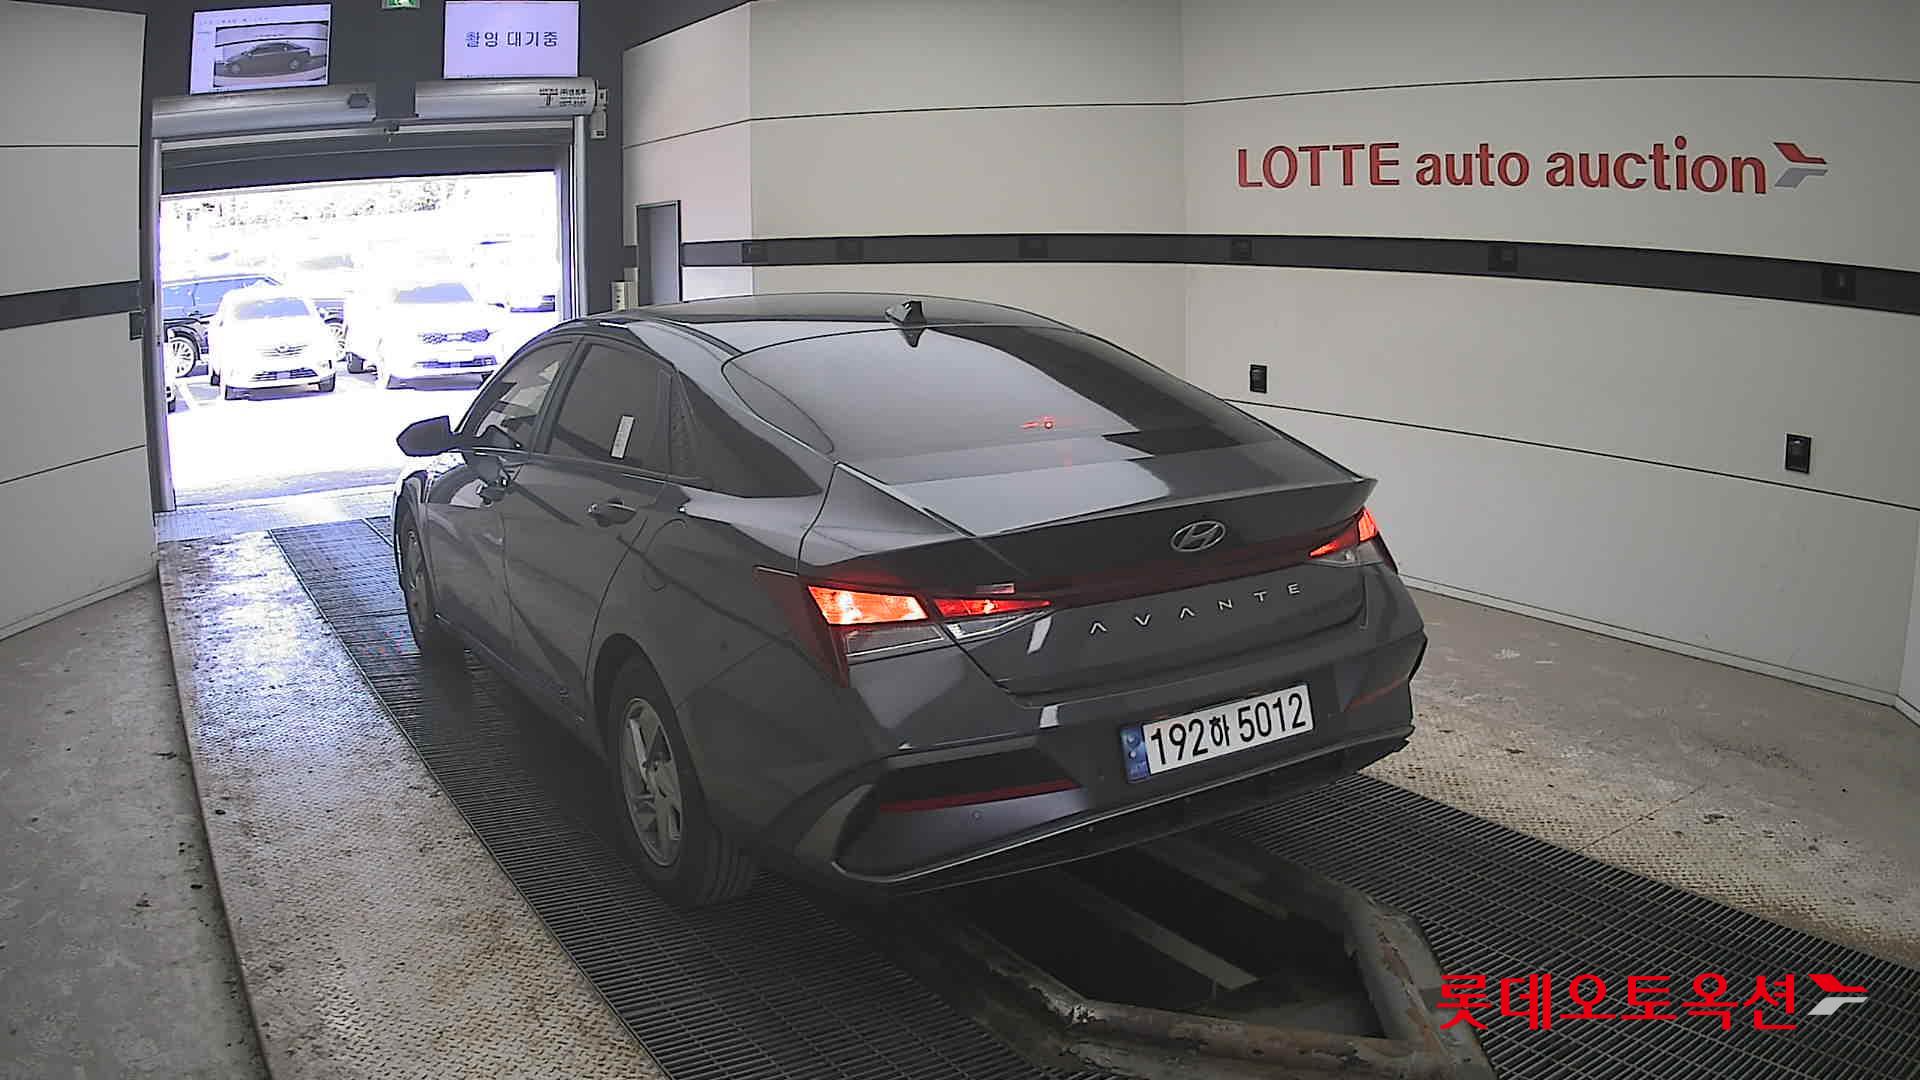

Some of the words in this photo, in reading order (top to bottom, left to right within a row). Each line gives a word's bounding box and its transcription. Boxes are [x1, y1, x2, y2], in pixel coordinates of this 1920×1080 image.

[507, 31, 558, 48] 대기중
[1237, 142, 1400, 189] LOTTE
[1416, 142, 1530, 187] auto
[1546, 135, 1767, 195] auction
[1089, 583, 1301, 635] AVANTE
[1151, 714, 1230, 765] 192하
[1238, 693, 1306, 742] 5012
